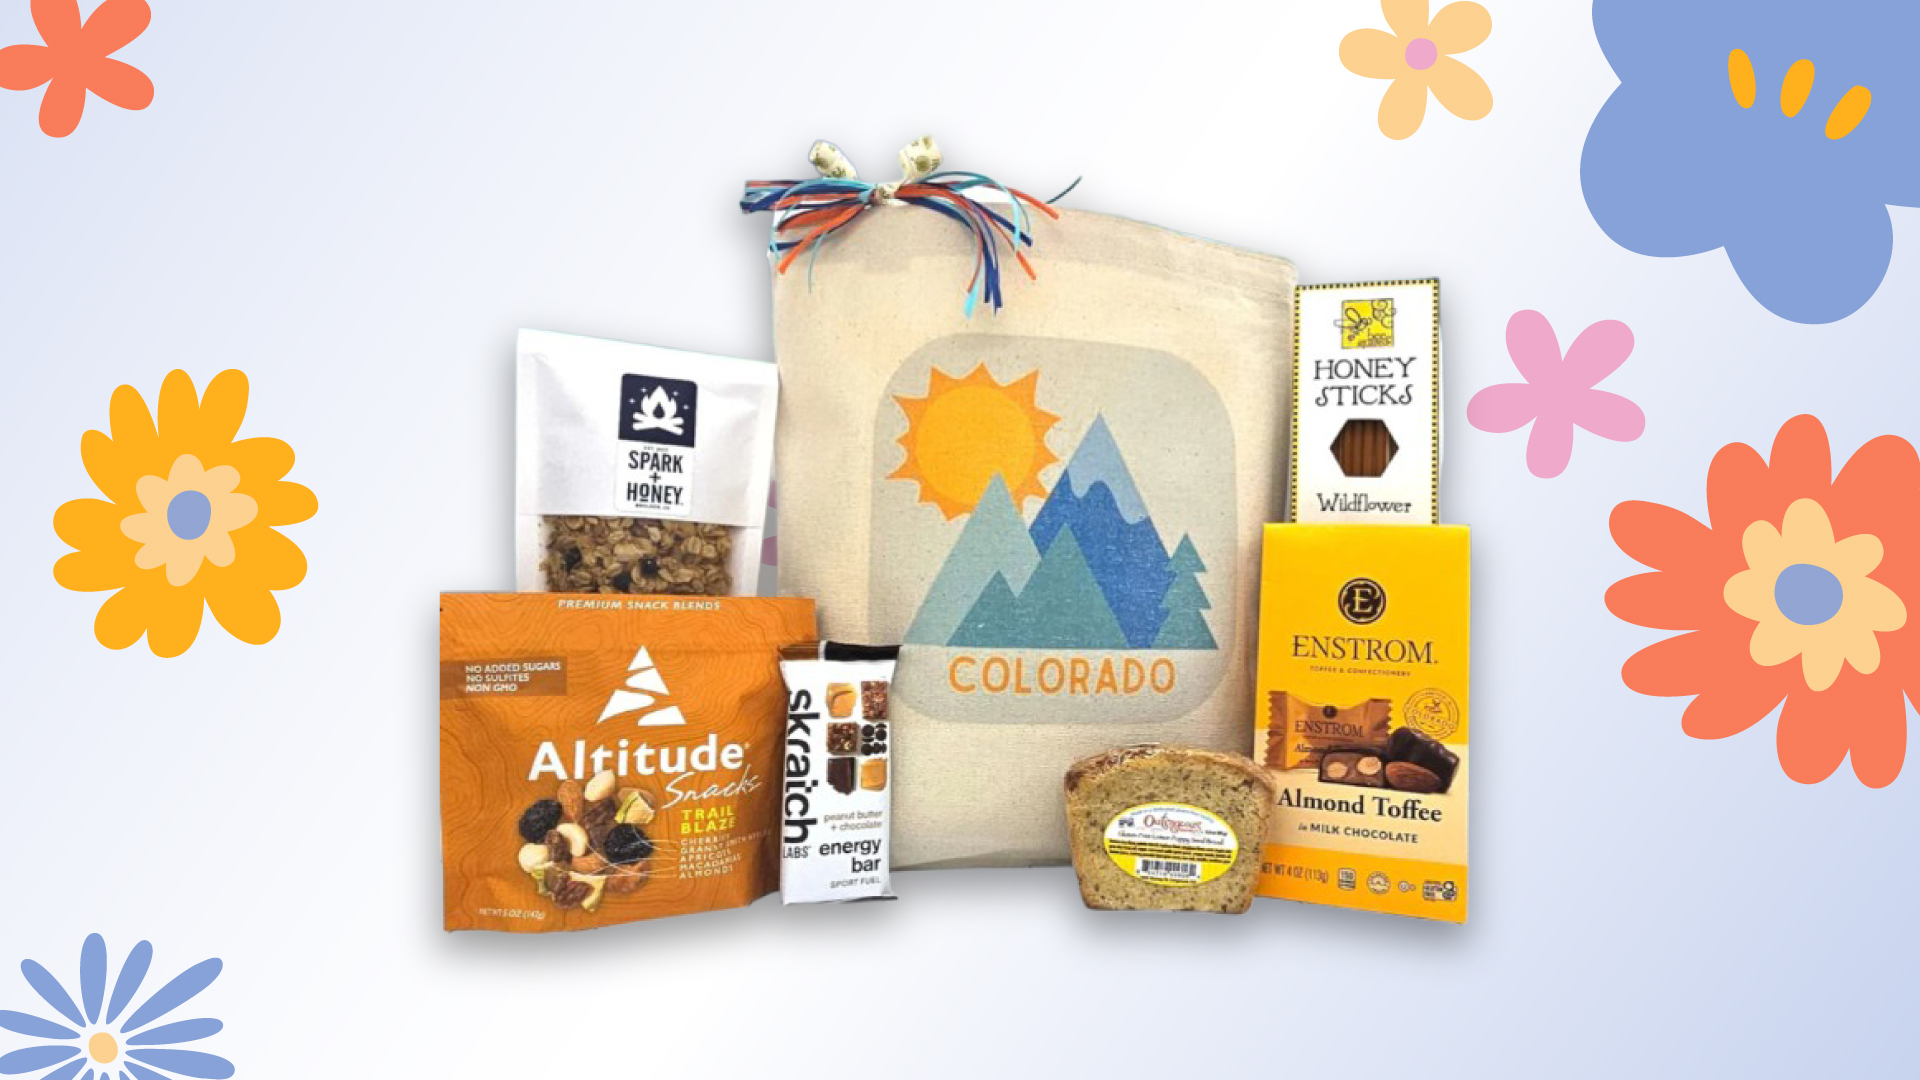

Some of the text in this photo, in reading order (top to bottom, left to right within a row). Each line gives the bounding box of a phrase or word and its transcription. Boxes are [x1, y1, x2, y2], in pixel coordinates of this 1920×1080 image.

[1313, 357, 1416, 380] HONEY
[1315, 384, 1413, 406] STICKS
[628, 450, 683, 473] SPARK
[627, 482, 684, 505] HONEY
[1316, 493, 1412, 513] Wildflower
[558, 599, 721, 611] PREMIUM SNACK BLENDS
[466, 662, 561, 674] NO ADDED SUGARS
[949, 656, 1176, 694] COLORADO
[466, 673, 530, 683] NO SULFITES
[466, 683, 518, 693] NON GMO
[1295, 720, 1364, 737] ENSTROM
[528, 733, 745, 781] Altitude
[784, 689, 820, 844] skratch
[661, 764, 761, 810] Snacks
[681, 805, 735, 821] TRAIL
[1278, 787, 1442, 822] Almond Toffee
[680, 817, 736, 834] BLAZE
[823, 810, 883, 825] peanut butter
[839, 820, 883, 832] chocolate
[1309, 823, 1339, 836] MILK
[1344, 827, 1418, 844] CHOCOLATE
[819, 838, 882, 857] energy
[851, 857, 882, 874] bar
[829, 876, 881, 889] SPORT FUEL
[1293, 866, 1303, 878] OZ
[1305, 868, 1328, 884] (113g)
